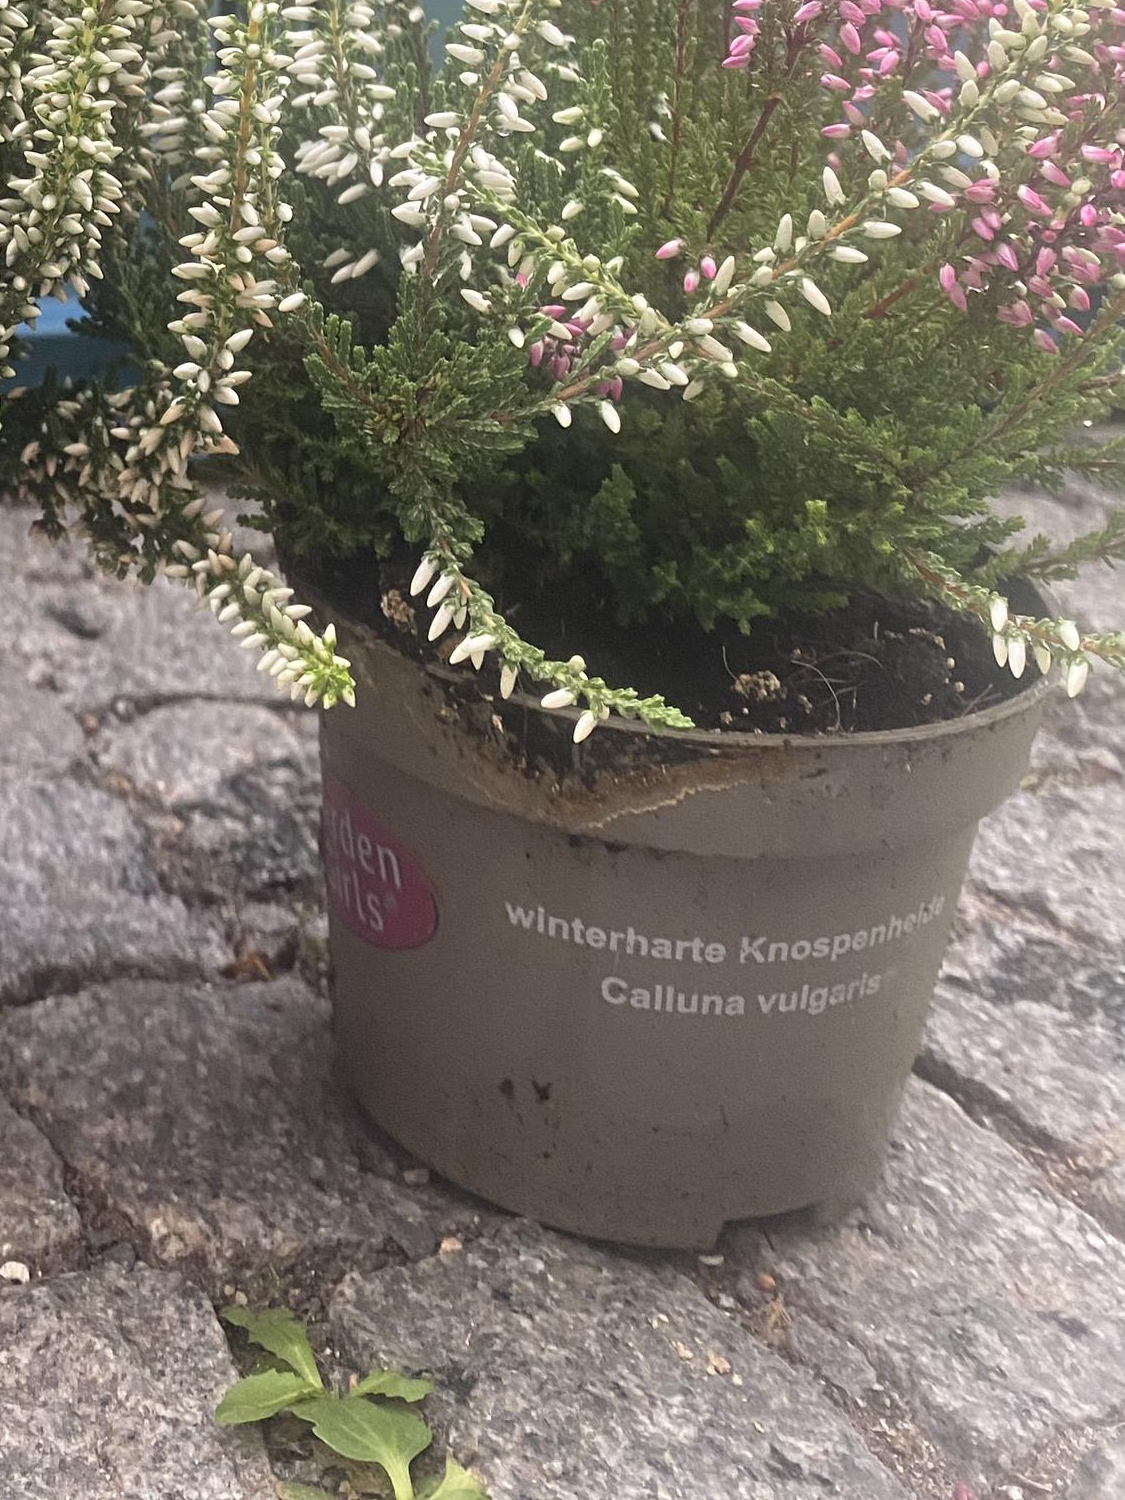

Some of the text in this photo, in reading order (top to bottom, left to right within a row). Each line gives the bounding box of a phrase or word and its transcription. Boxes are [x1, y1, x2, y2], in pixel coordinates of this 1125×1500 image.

[504, 902, 726, 964] winterharte
[601, 972, 882, 1016] Calluna vulgaris
